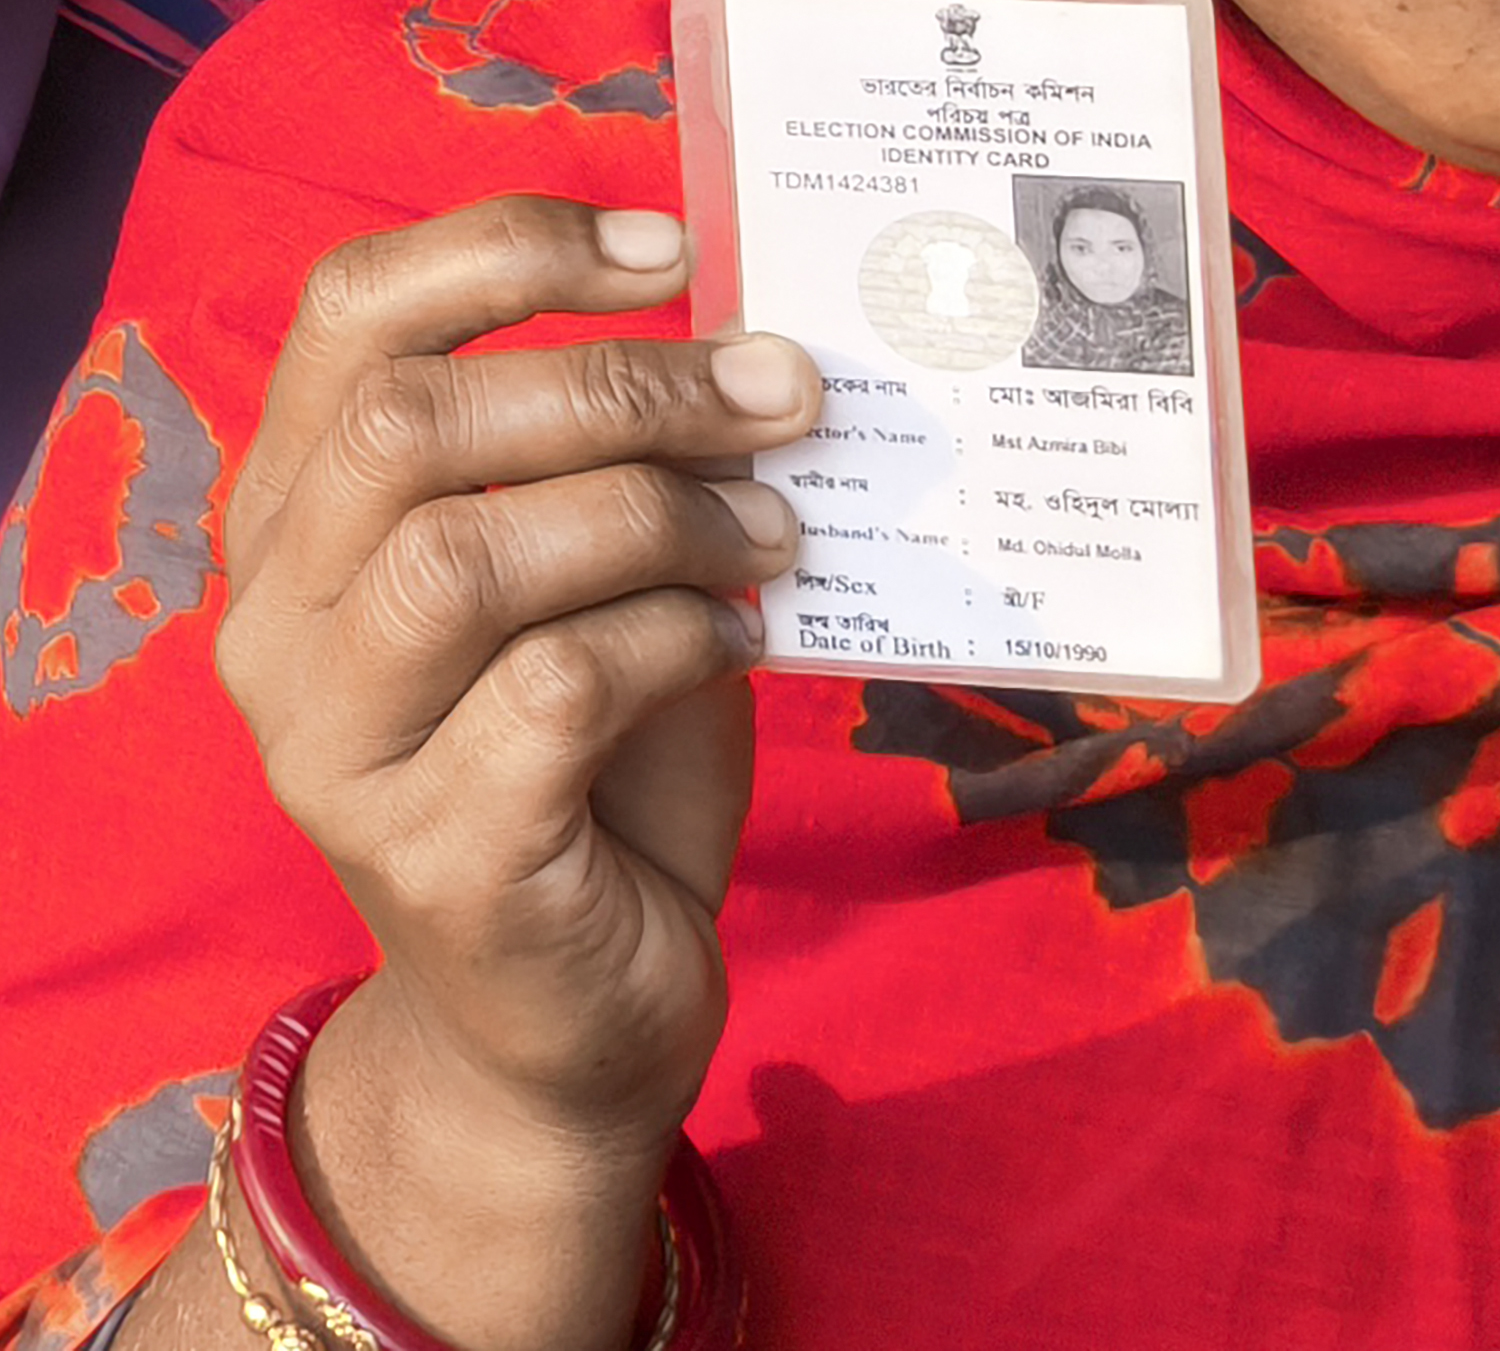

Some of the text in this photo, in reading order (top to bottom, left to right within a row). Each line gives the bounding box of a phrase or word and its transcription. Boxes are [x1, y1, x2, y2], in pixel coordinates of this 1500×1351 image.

[860, 75, 1095, 103] ভারতের নির্বাচন কমিশন
[927, 101, 1031, 126] পরিচয় পত্র
[785, 120, 1153, 150] ELECTION COMMISSION OF INDIA
[880, 147, 1051, 170] IDENTITY CARD
[769, 170, 920, 195] TDM1424381
[819, 376, 870, 395] চকের
[987, 384, 1194, 415] মোঃ আজমিরা বিবি
[1092, 437, 1128, 457] Bibi
[1032, 539, 1092, 559] Ohidul
[1096, 543, 1143, 562] Molla
[799, 628, 1108, 663] Date of Birth 15/10/1990
